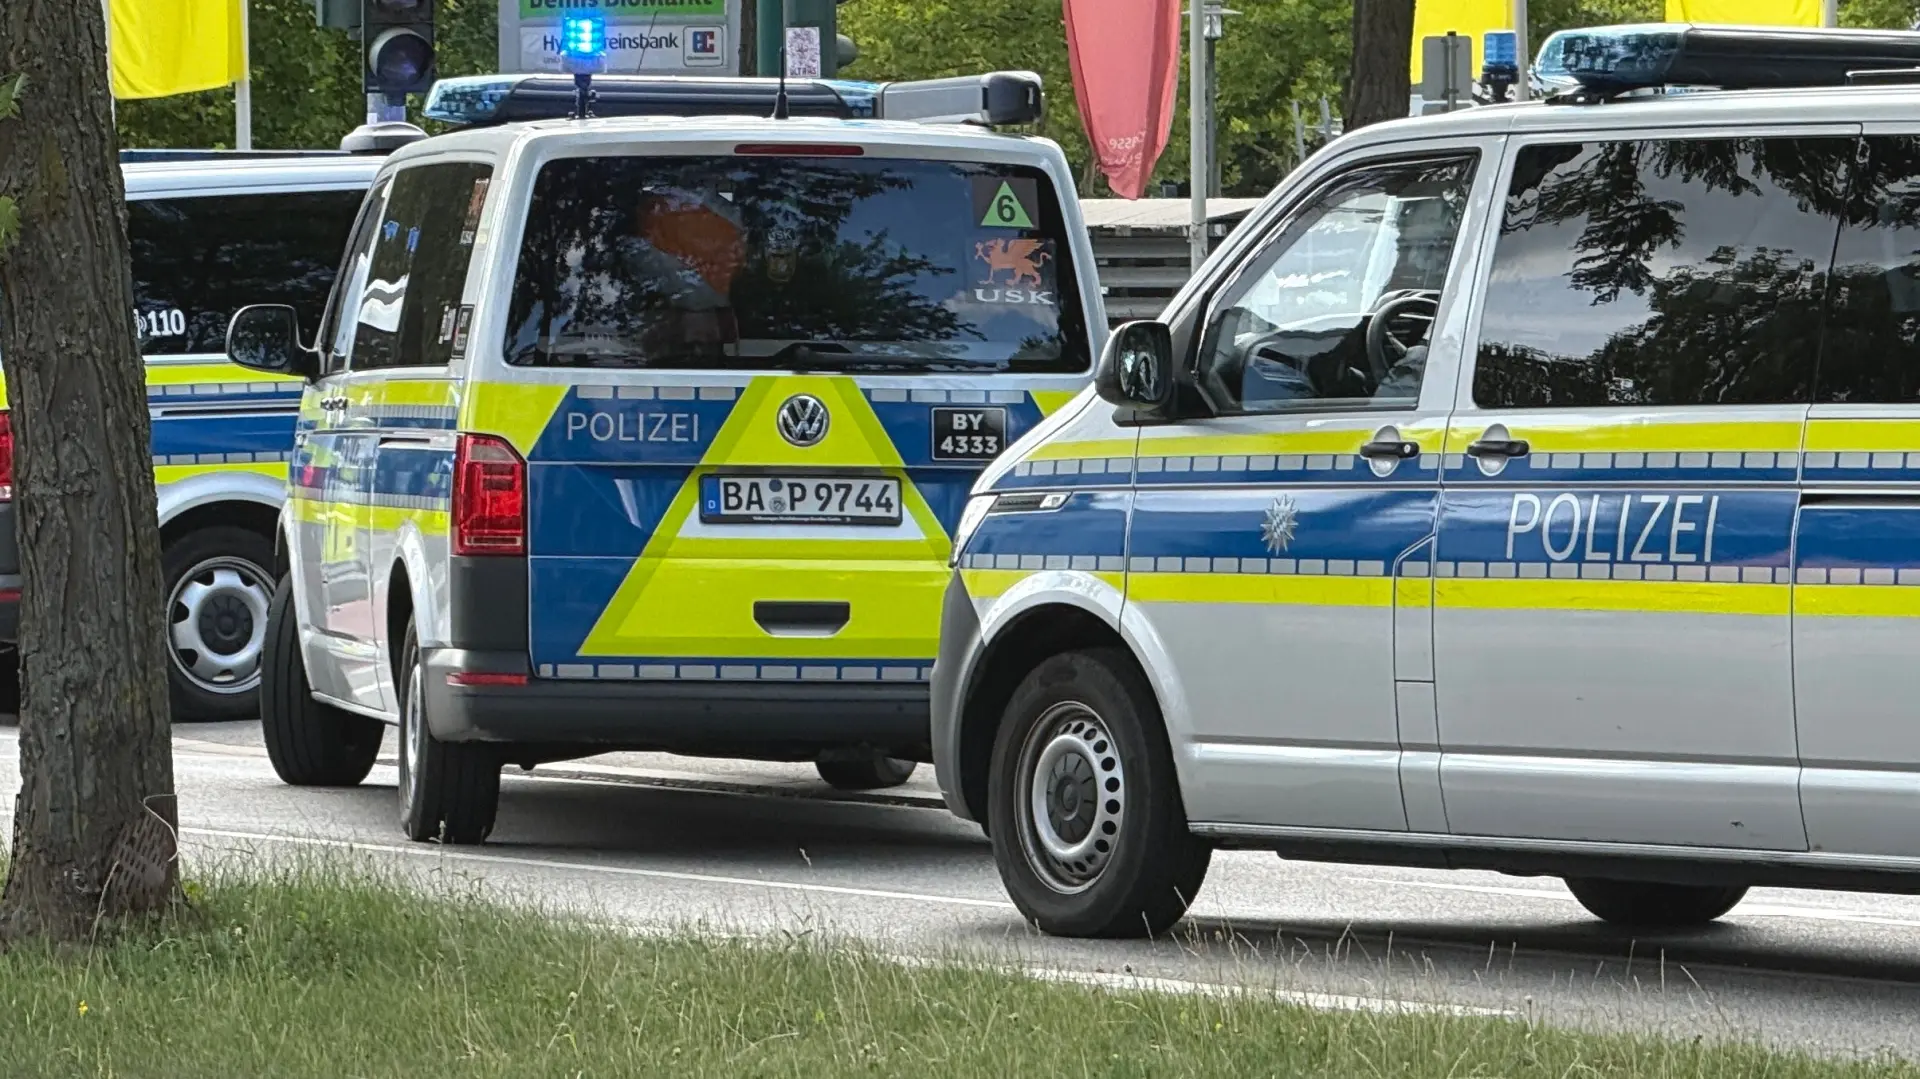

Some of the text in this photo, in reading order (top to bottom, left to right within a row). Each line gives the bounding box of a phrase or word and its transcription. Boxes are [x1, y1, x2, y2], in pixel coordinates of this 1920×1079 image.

[543, 34, 678, 55] Hyreinsbank
[996, 194, 1016, 223] 6
[973, 288, 1055, 305] USK
[147, 309, 186, 336] 110
[567, 411, 699, 443] POLIZEI
[951, 413, 984, 431] BY
[940, 436, 999, 455] 4333
[708, 499, 716, 509] D
[722, 481, 765, 511] BA
[1505, 492, 1719, 563] POLIZEI
